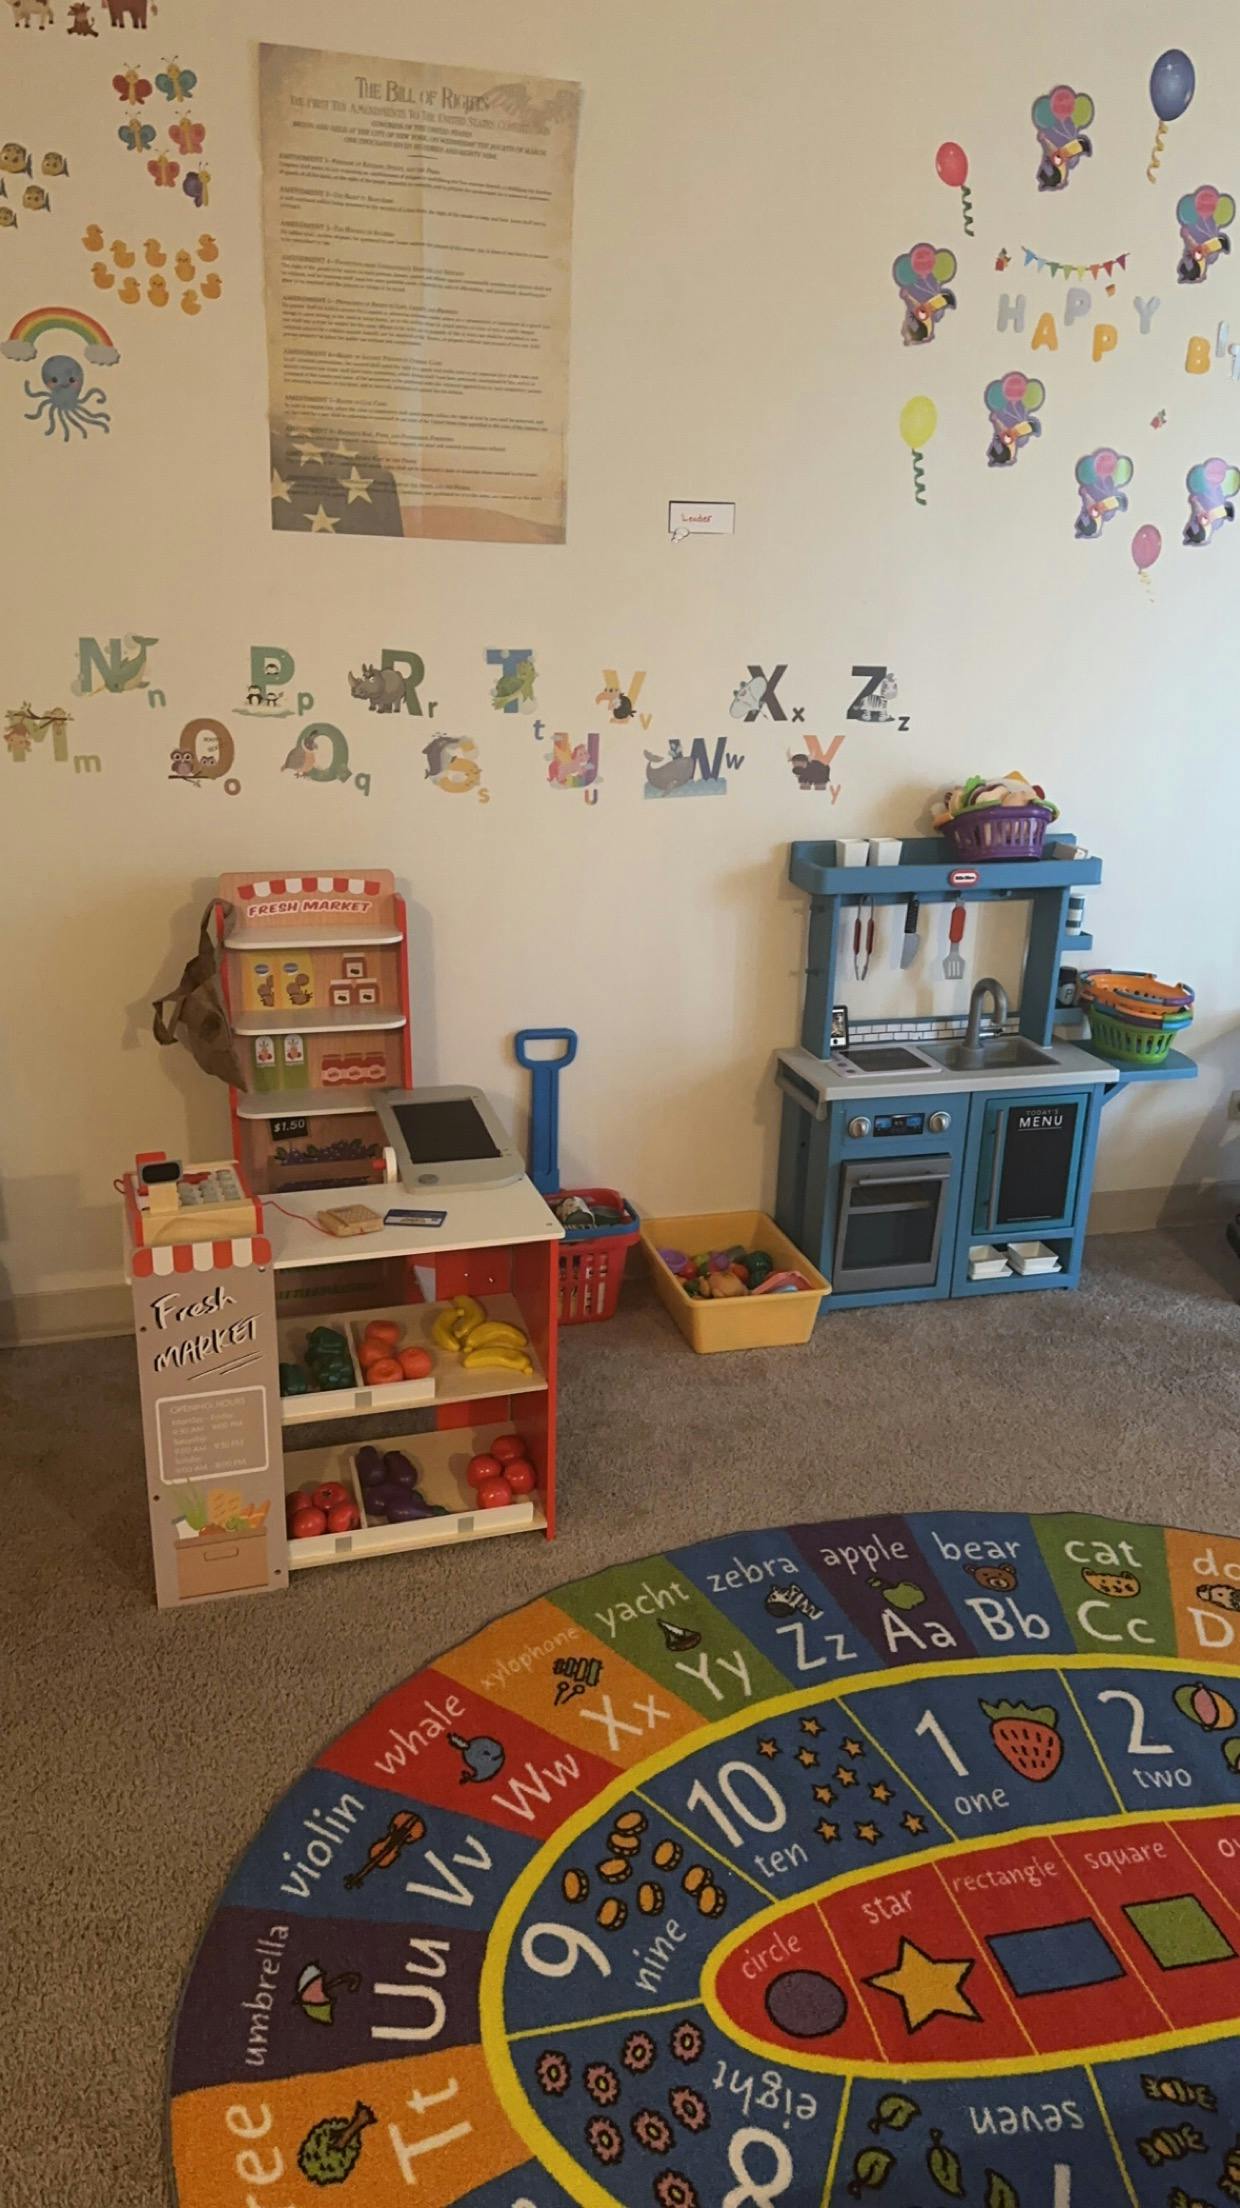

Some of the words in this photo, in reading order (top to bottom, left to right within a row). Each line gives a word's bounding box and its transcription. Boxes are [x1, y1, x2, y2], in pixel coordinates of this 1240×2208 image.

[354, 76, 382, 99] THE
[385, 80, 416, 103] BILL
[420, 90, 438, 106] OF
[997, 288, 1160, 362] HAPPY
[79, 637, 122, 693] N
[147, 689, 167, 709] n
[250, 645, 295, 702] P
[297, 691, 314, 716] p
[382, 648, 425, 716] R
[428, 700, 438, 718] r
[486, 648, 533, 714] T
[533, 719, 545, 740] t
[602, 669, 647, 723] V
[639, 713, 653, 730] v
[743, 664, 788, 722] X
[791, 706, 805, 722] x
[846, 665, 888, 721] Z
[898, 716, 910, 731] z
[8, 710, 69, 762] M
[74, 754, 102, 774] m
[179, 718, 235, 779] O
[223, 778, 242, 796] o
[296, 722, 352, 783] Q
[354, 772, 371, 797] q
[551, 733, 600, 788] U
[584, 789, 598, 805] u
[668, 737, 728, 780] W
[725, 752, 745, 770] w
[248, 902, 298, 916] FRESH
[303, 900, 370, 913] MARKET
[273, 1119, 305, 1133] $1.50
[1019, 1115, 1063, 1128] MENU
[151, 1286, 237, 1330] Fresh
[153, 1313, 262, 1373] MARKET
[706, 1556, 800, 1593] zebra
[820, 1533, 910, 1575] apple
[931, 1531, 1021, 1561] bear
[1064, 1540, 1142, 1567] cat
[595, 1580, 691, 1638] yacht
[881, 1607, 957, 1654] Aa
[964, 1597, 1050, 1642] Bb
[1076, 1600, 1155, 1644] Cc
[480, 1626, 580, 1690] xylophone
[675, 1650, 753, 1701] Yy
[775, 1622, 858, 1671] Zz
[374, 1694, 467, 1775] whale
[579, 1694, 671, 1752] Xx
[914, 1709, 969, 1777] 1
[1097, 1689, 1174, 1755] 2
[491, 1753, 581, 1822] Ww
[687, 1760, 787, 1848] 10
[954, 1788, 1010, 1816] one
[1133, 1767, 1192, 1789] two
[279, 1793, 365, 1898] violin
[405, 1834, 493, 1907] Vv
[754, 1843, 809, 1879] ten
[952, 1855, 1058, 1894] rectangle
[1084, 1840, 1168, 1876] square
[861, 1888, 914, 1924] star
[521, 1921, 612, 1978] 9
[635, 1918, 688, 1994] nine
[741, 1931, 803, 1981] circle
[241, 1923, 290, 2067] umbrella
[371, 1937, 450, 2042] Uu
[712, 2060, 818, 2130] eight
[970, 2100, 1085, 2135] seven
[225, 2103, 296, 2208] ee
[388, 2077, 473, 2186] Tt
